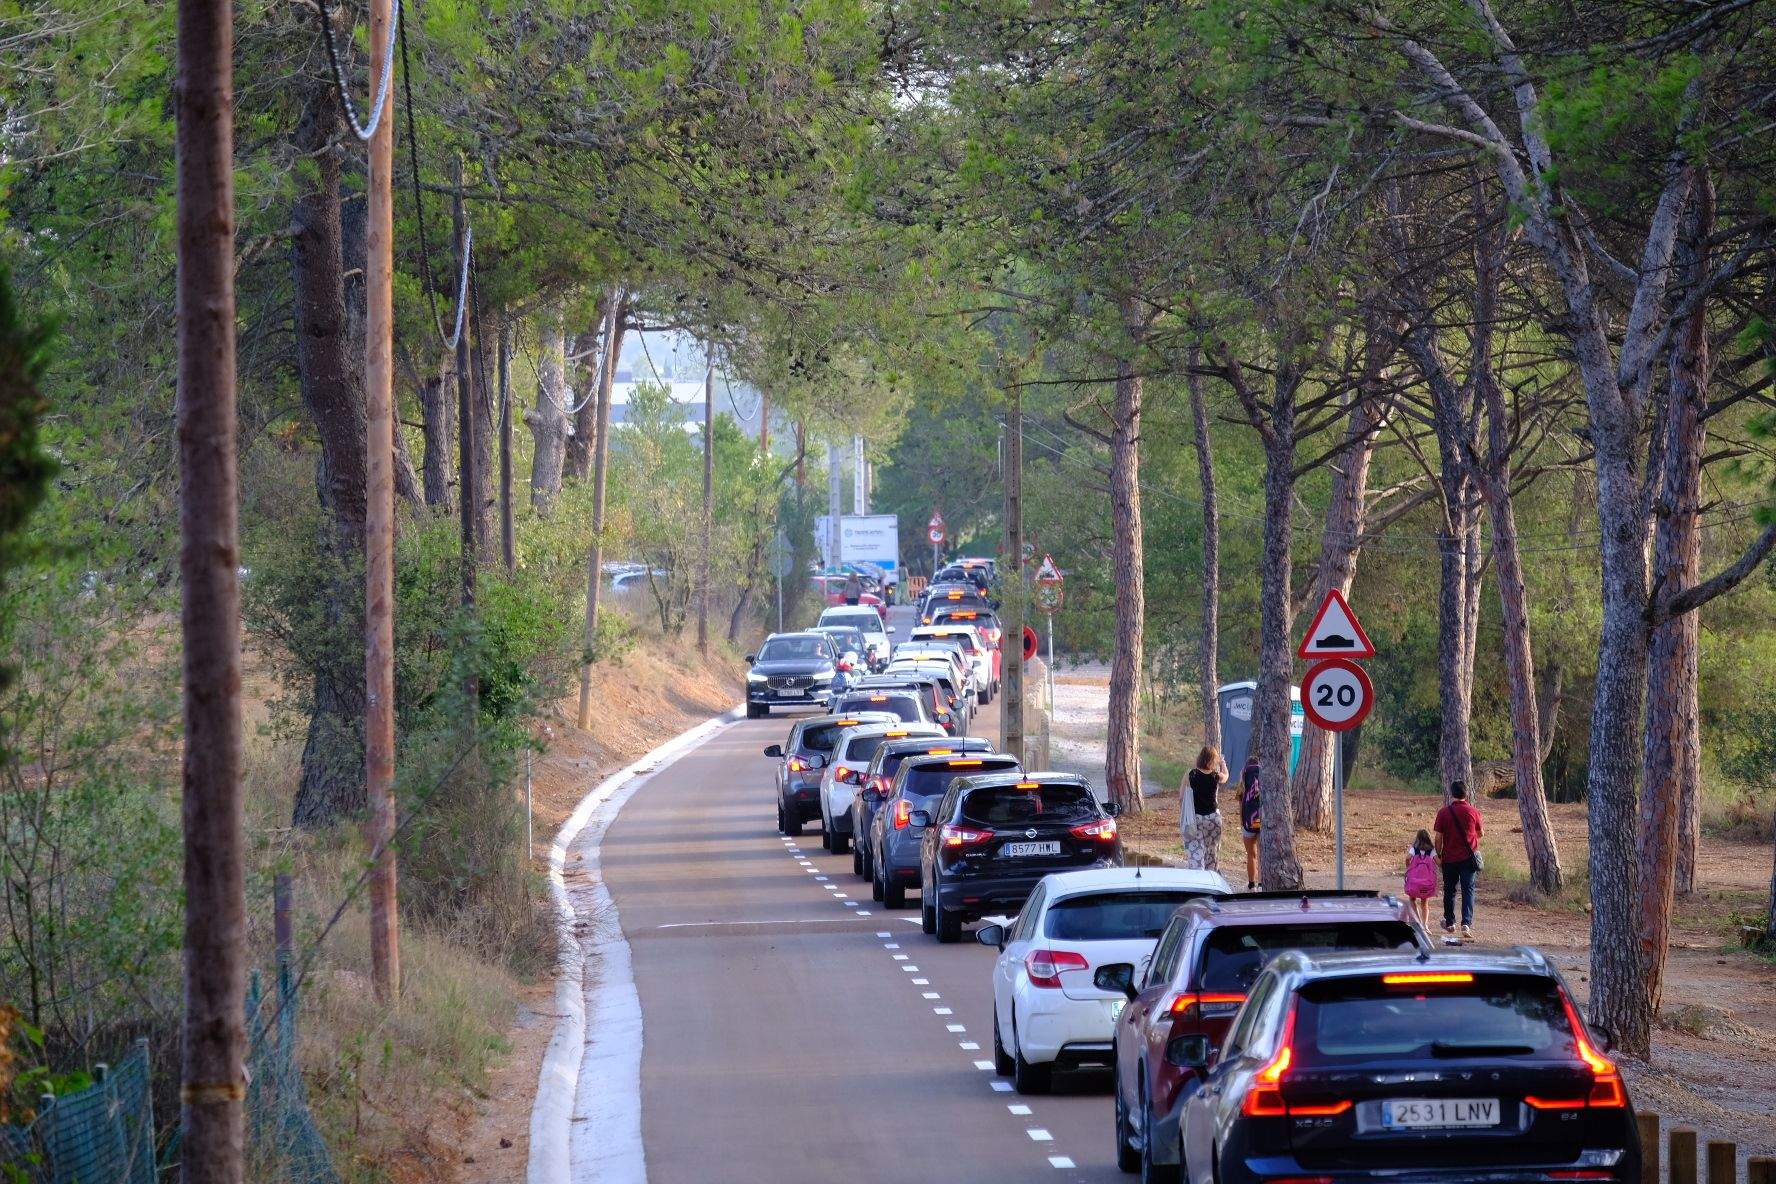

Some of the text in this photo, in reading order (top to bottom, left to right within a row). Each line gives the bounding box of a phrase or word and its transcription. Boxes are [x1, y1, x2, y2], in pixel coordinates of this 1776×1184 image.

[1317, 684, 1356, 707] 20
[1012, 843, 1037, 855] 8577
[1397, 1102, 1492, 1123] 2531 LNV
